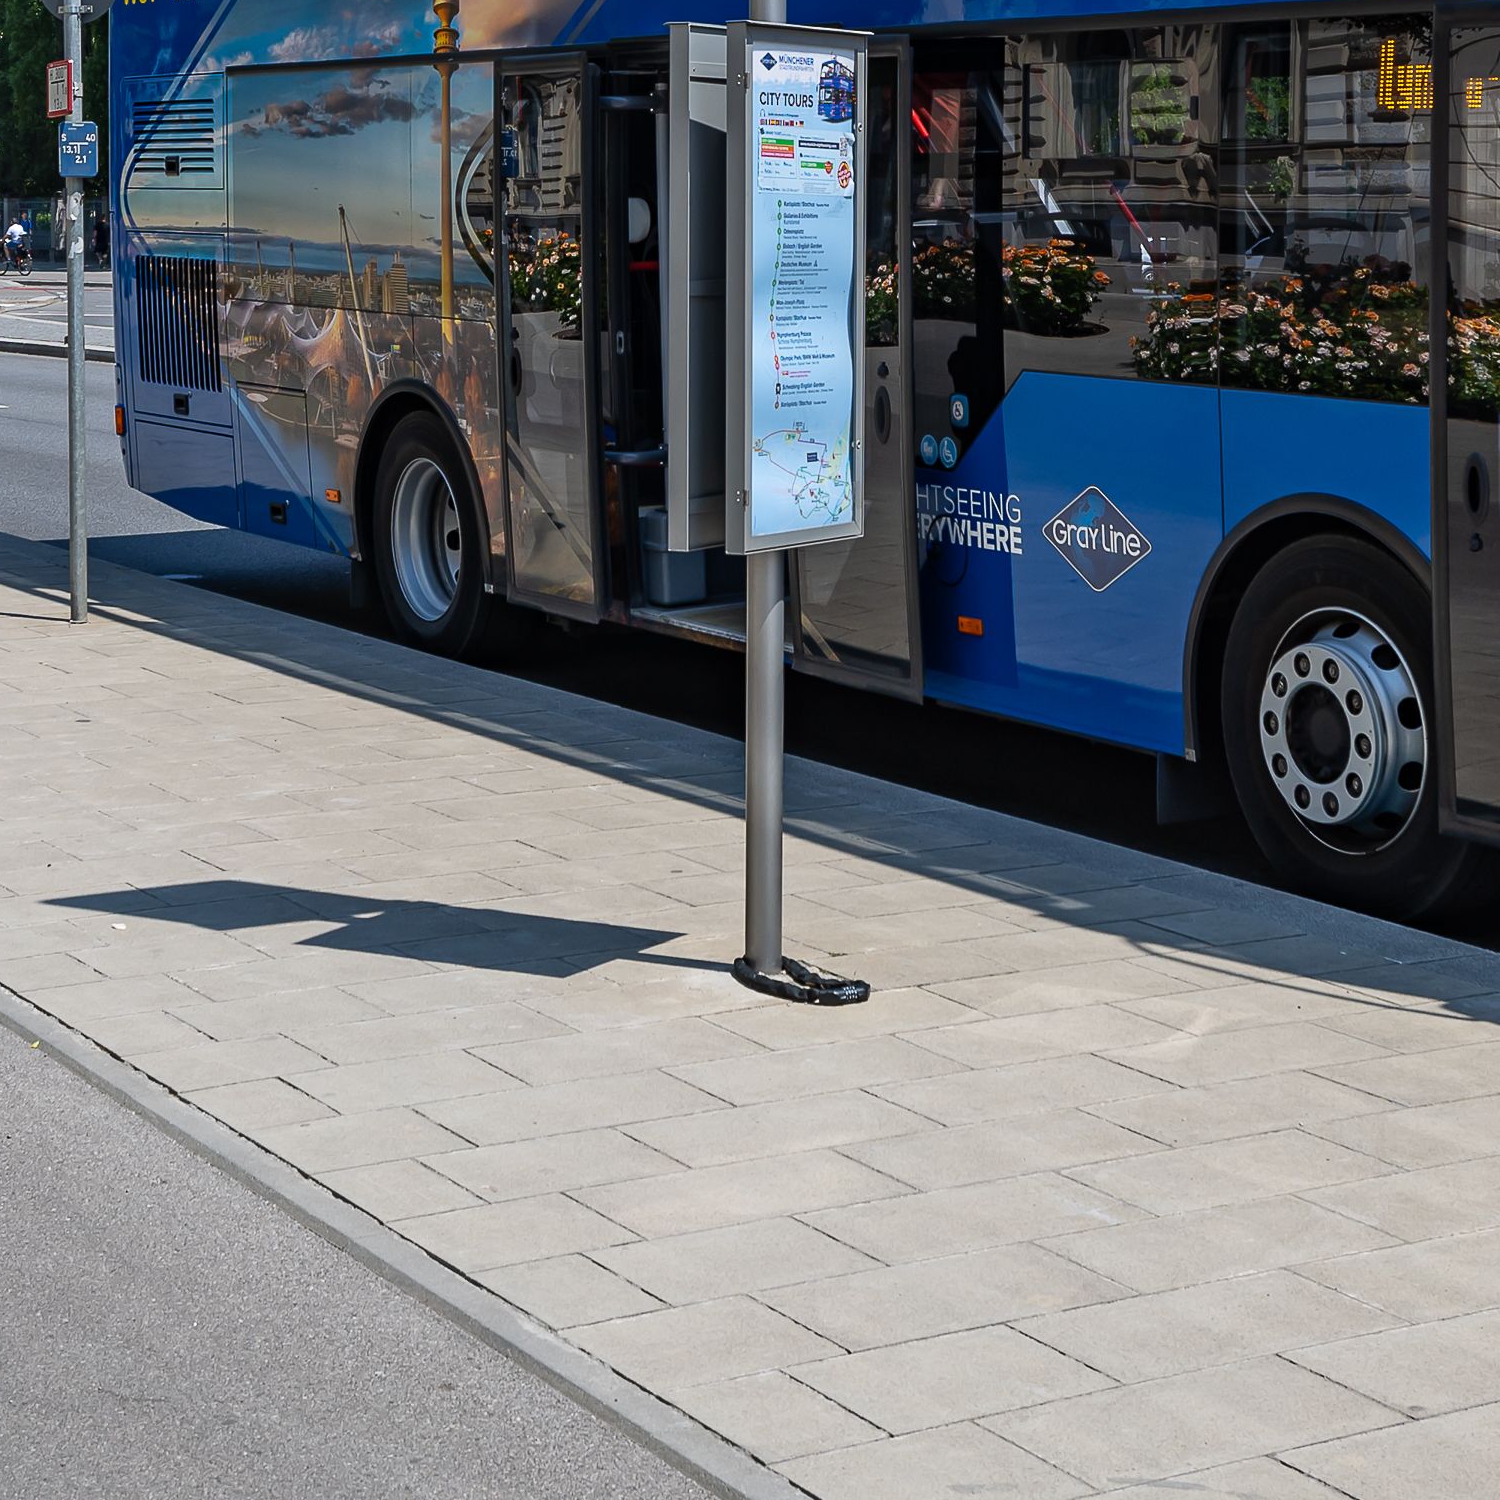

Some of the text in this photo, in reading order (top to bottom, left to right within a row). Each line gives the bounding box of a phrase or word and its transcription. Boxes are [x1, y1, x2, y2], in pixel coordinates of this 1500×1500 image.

[760, 92, 813, 108] CITY TOURS
[61, 134, 95, 142] S 40
[75, 155, 87, 164] 2.1
